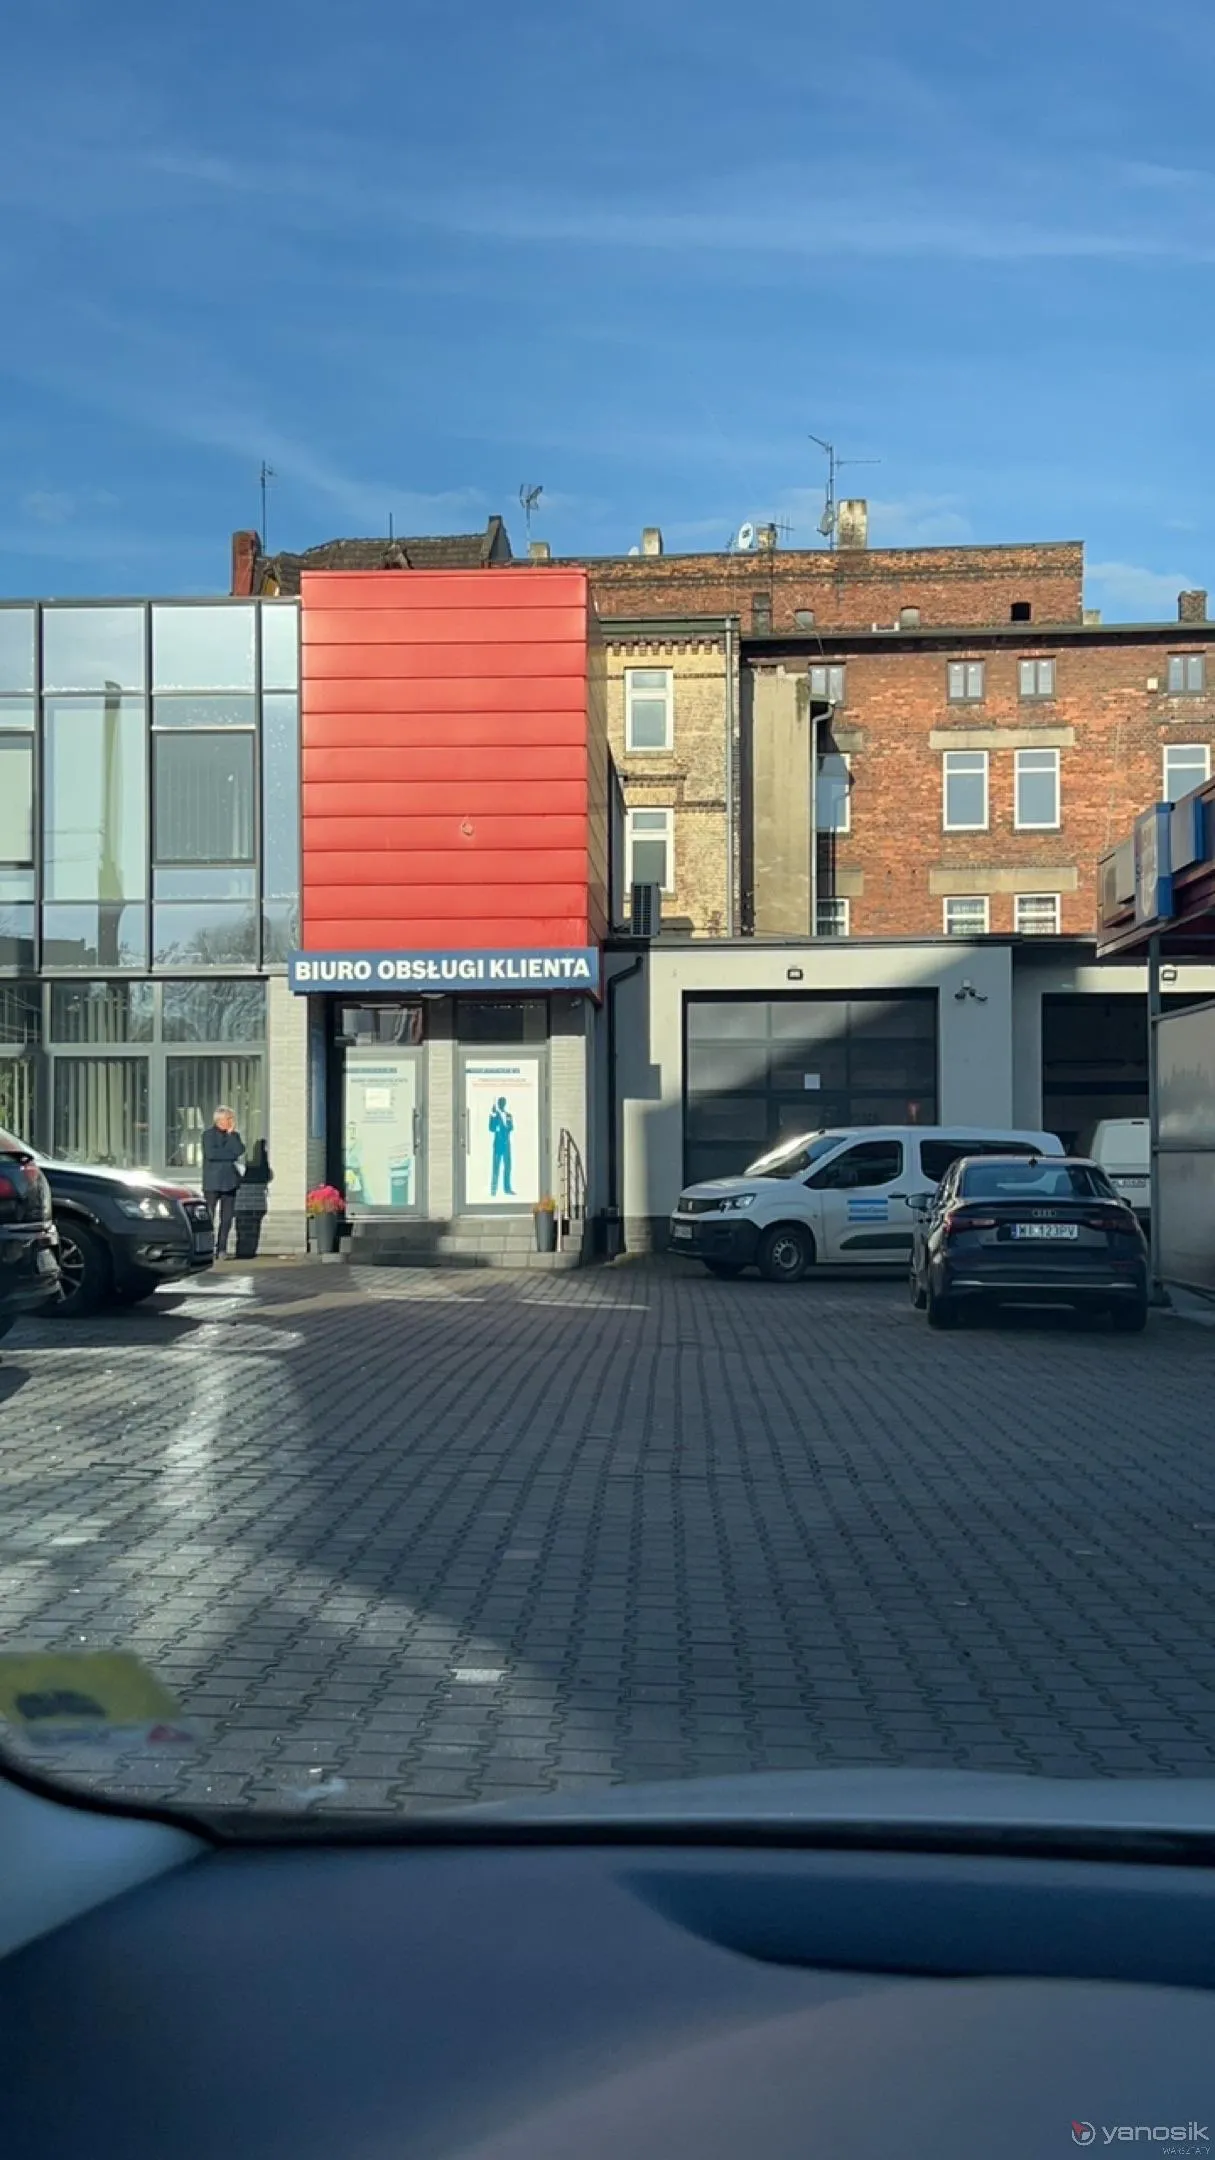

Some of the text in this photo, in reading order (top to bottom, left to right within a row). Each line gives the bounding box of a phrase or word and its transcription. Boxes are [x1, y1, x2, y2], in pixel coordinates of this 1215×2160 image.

[295, 957, 590, 980] BIURO OBSŁUGI KLIENTA
